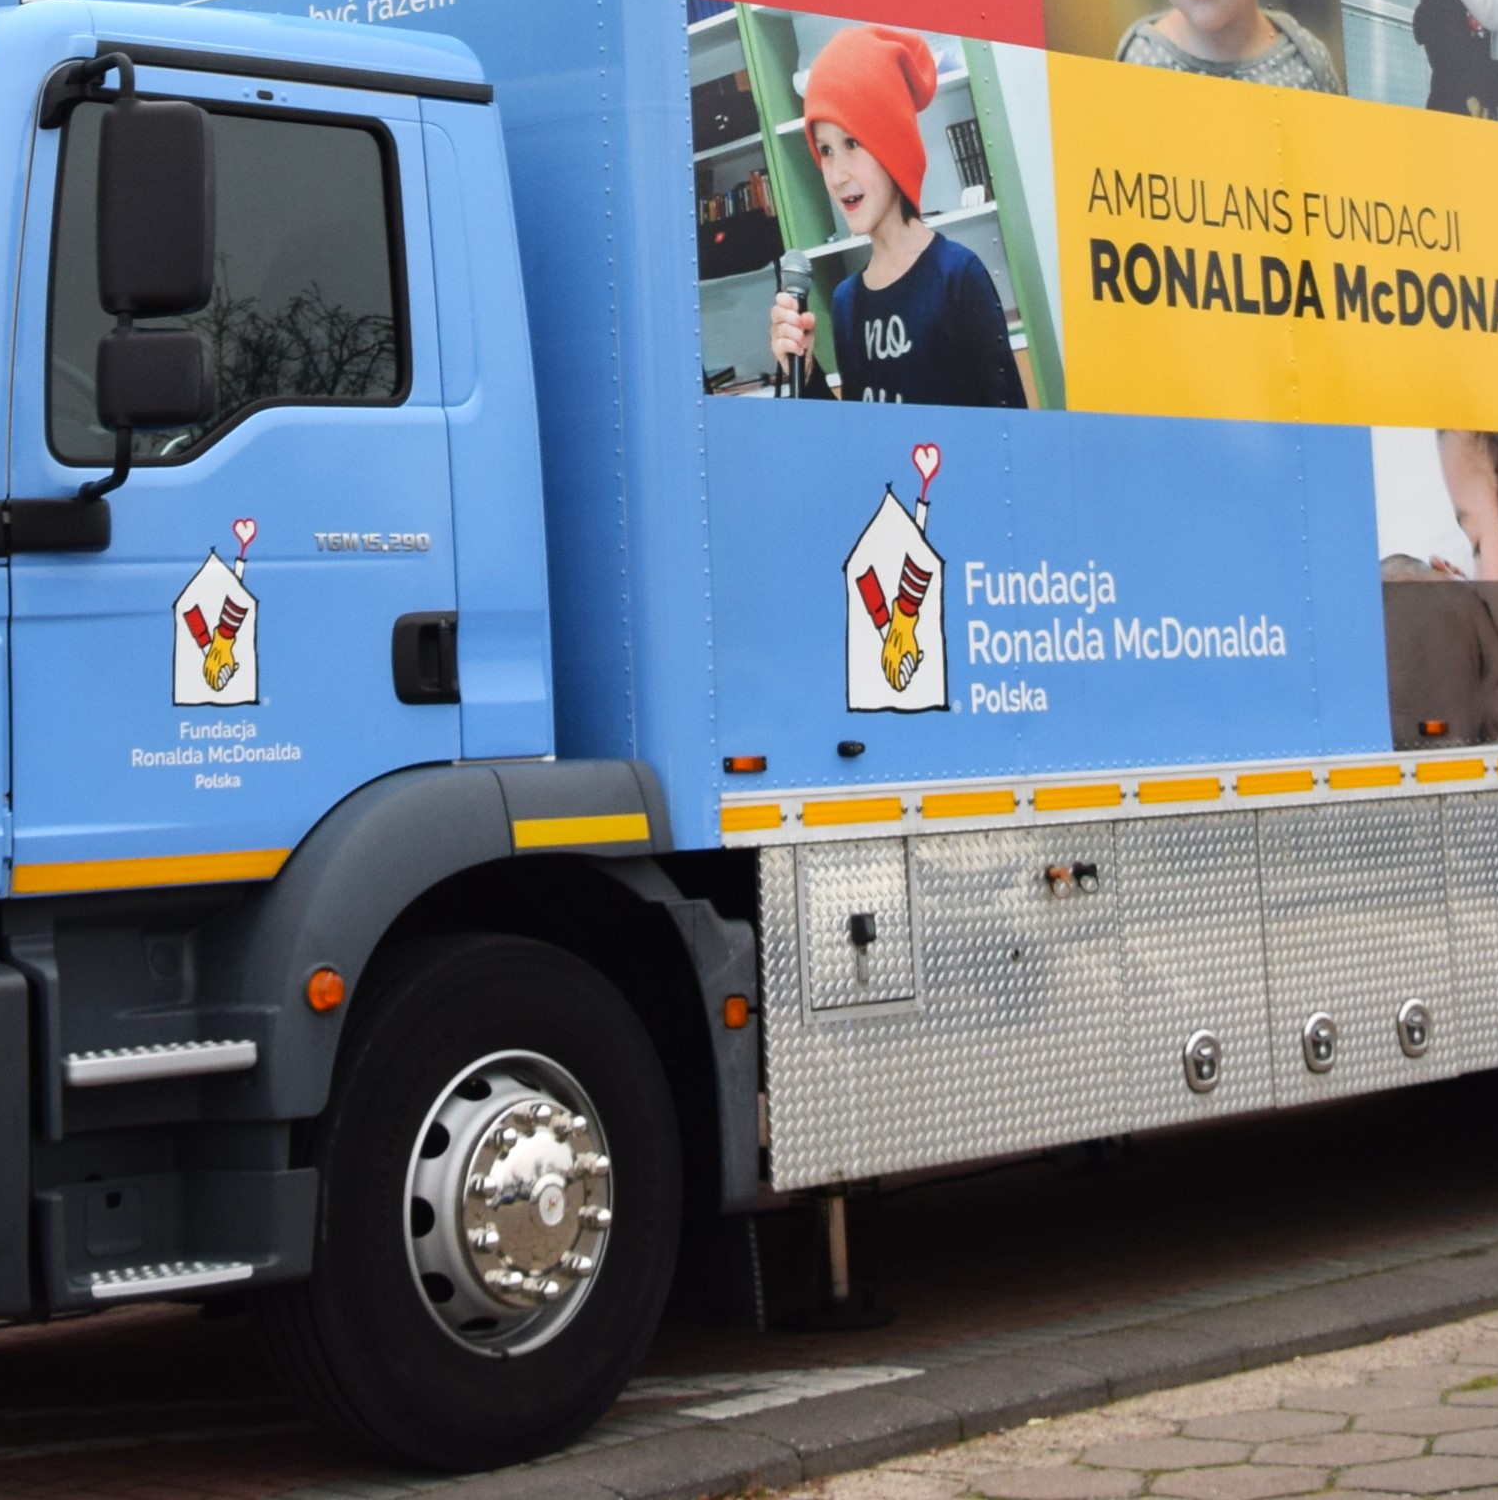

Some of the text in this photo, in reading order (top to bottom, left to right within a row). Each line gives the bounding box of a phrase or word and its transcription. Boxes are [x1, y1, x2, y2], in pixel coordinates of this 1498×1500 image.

[1088, 167, 1461, 253] AMBULANS FUNDACJI
[1089, 238, 1325, 320] RONALDA
[865, 314, 912, 361] no
[314, 532, 431, 552] TGM 15.290
[964, 561, 1117, 613] Fundacja
[968, 614, 1287, 665] Ronalda McDonalda
[971, 681, 1048, 714] Polska
[179, 720, 257, 742] Fundacja
[131, 742, 302, 767] Ronalda McDonalda
[194, 774, 241, 789] Polska
